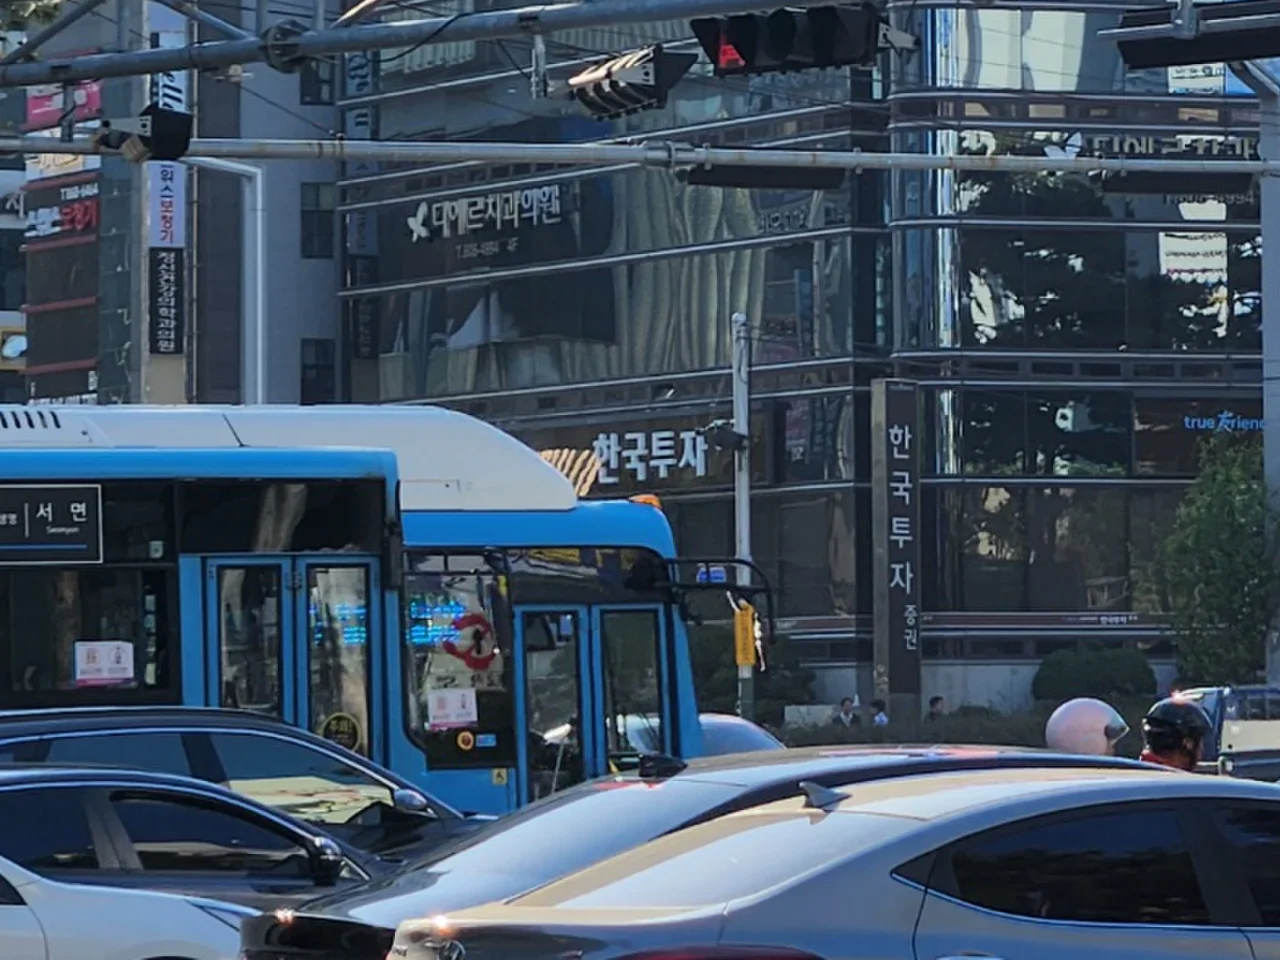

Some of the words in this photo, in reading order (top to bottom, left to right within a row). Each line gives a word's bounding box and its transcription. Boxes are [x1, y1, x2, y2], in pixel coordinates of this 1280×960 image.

[592, 430, 709, 484] 한국투자
[888, 423, 914, 595] 한국투자
[903, 604, 918, 650] 증권
